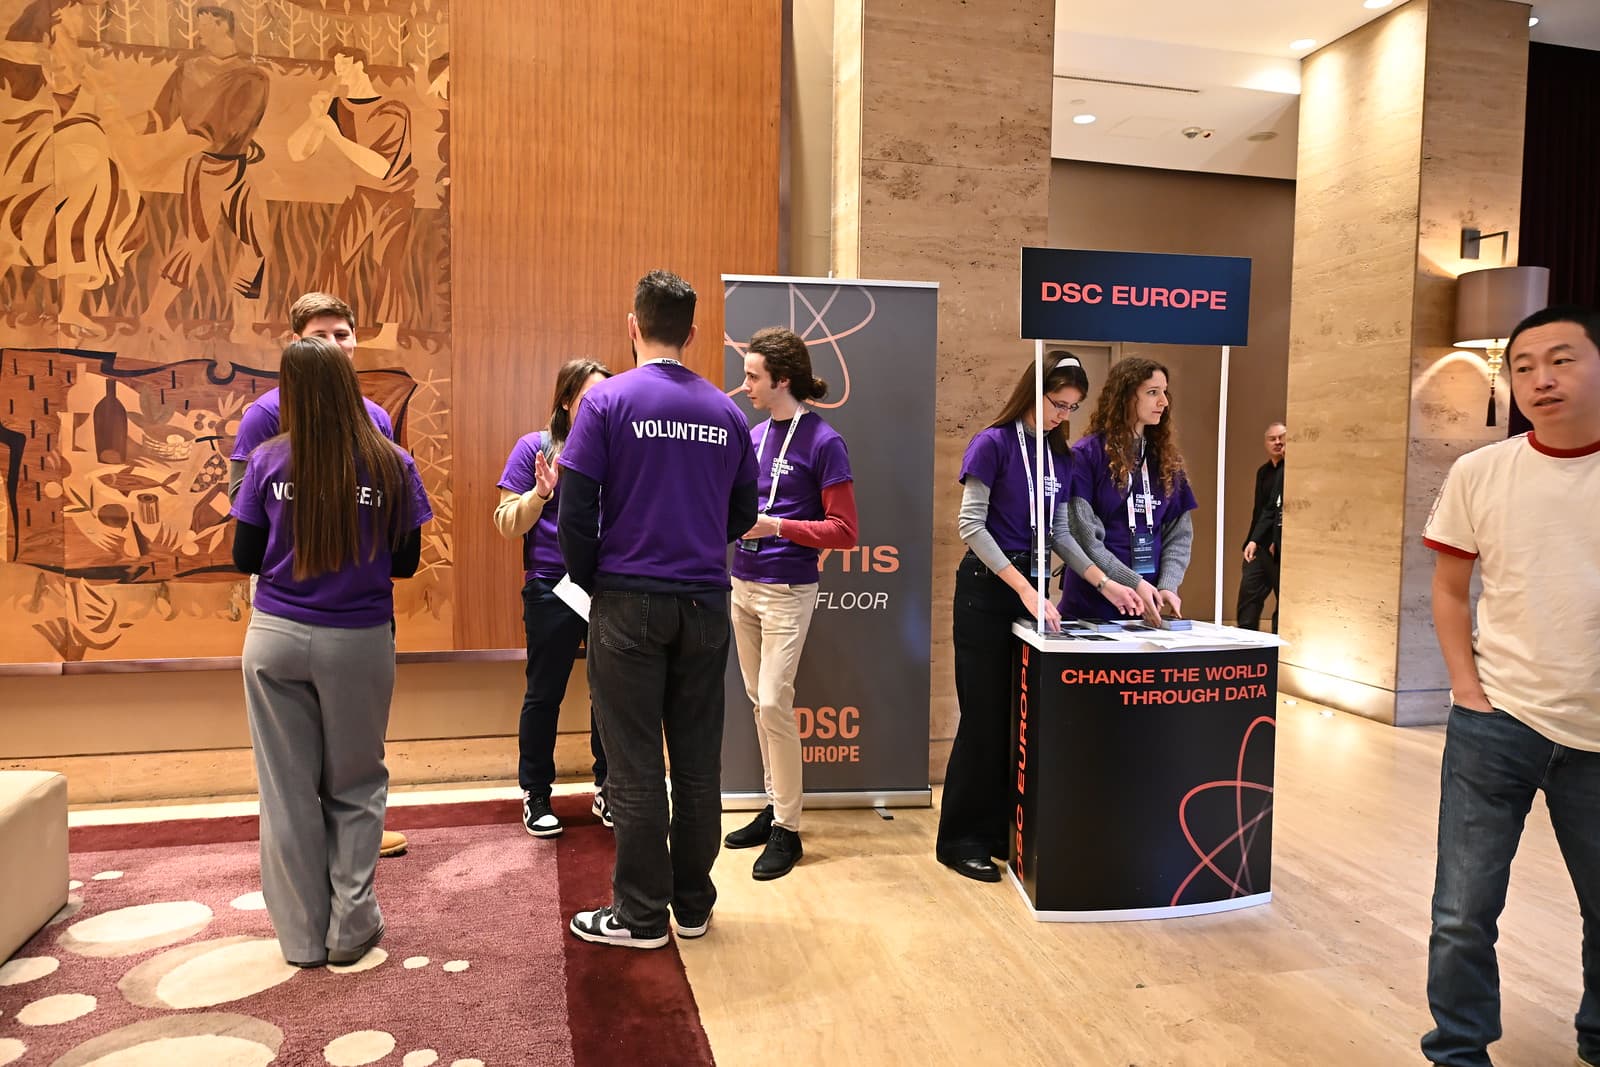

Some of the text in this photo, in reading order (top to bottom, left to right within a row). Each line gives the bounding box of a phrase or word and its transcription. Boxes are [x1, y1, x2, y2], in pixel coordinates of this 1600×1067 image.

[1041, 282, 1227, 311] DSC EUROPE
[632, 419, 728, 447] VOLUNTEER
[817, 545, 899, 573] YTIS
[814, 592, 889, 610] FLOOR
[1061, 663, 1268, 684] CHANGE THE WORLD
[1120, 684, 1267, 705] THROUGH DATA
[794, 706, 860, 739] DSC
[802, 746, 860, 763] UROPE
[1016, 643, 1029, 883] DSC EUROPE
